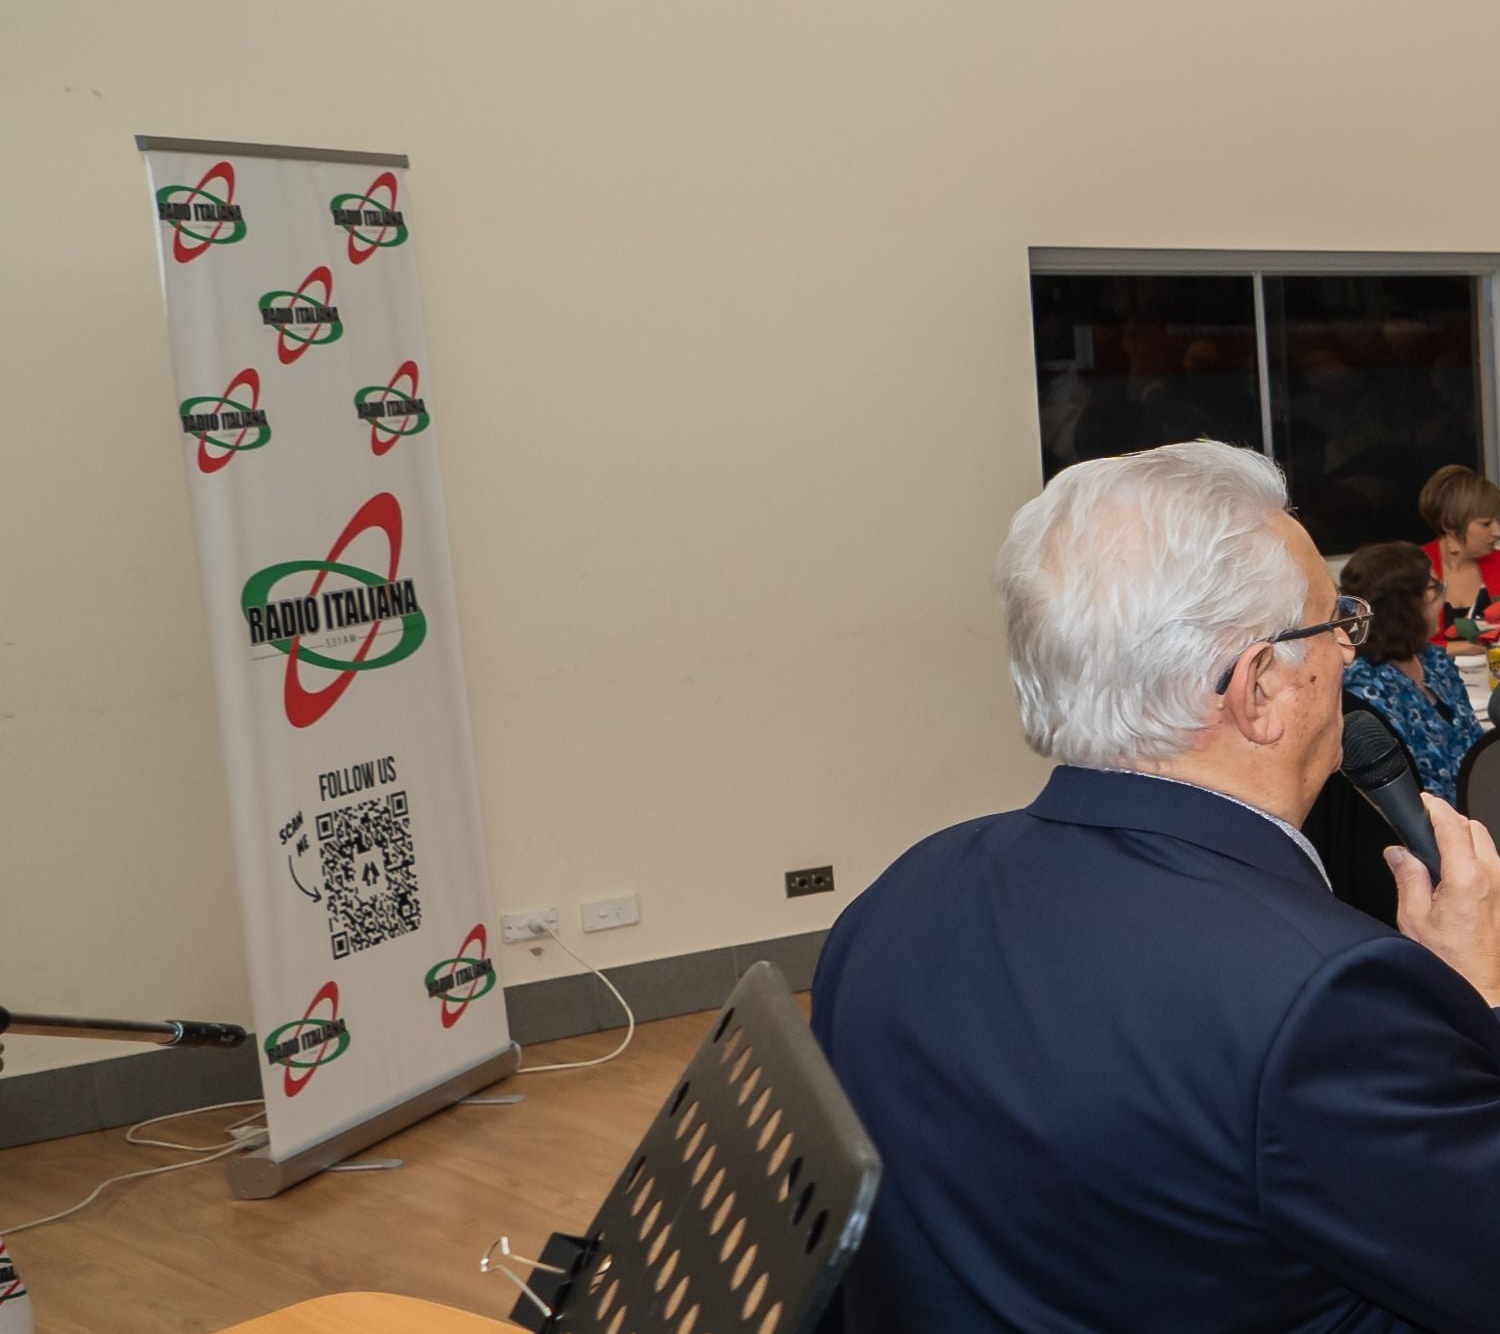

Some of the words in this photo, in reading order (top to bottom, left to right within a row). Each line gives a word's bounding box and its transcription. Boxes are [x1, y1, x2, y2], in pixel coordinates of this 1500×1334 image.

[248, 597, 319, 647] RADIO
[322, 578, 419, 638] ITALIANA
[318, 761, 375, 802] FOLLOW
[377, 755, 397, 785] US
[279, 810, 303, 846] SCAN
